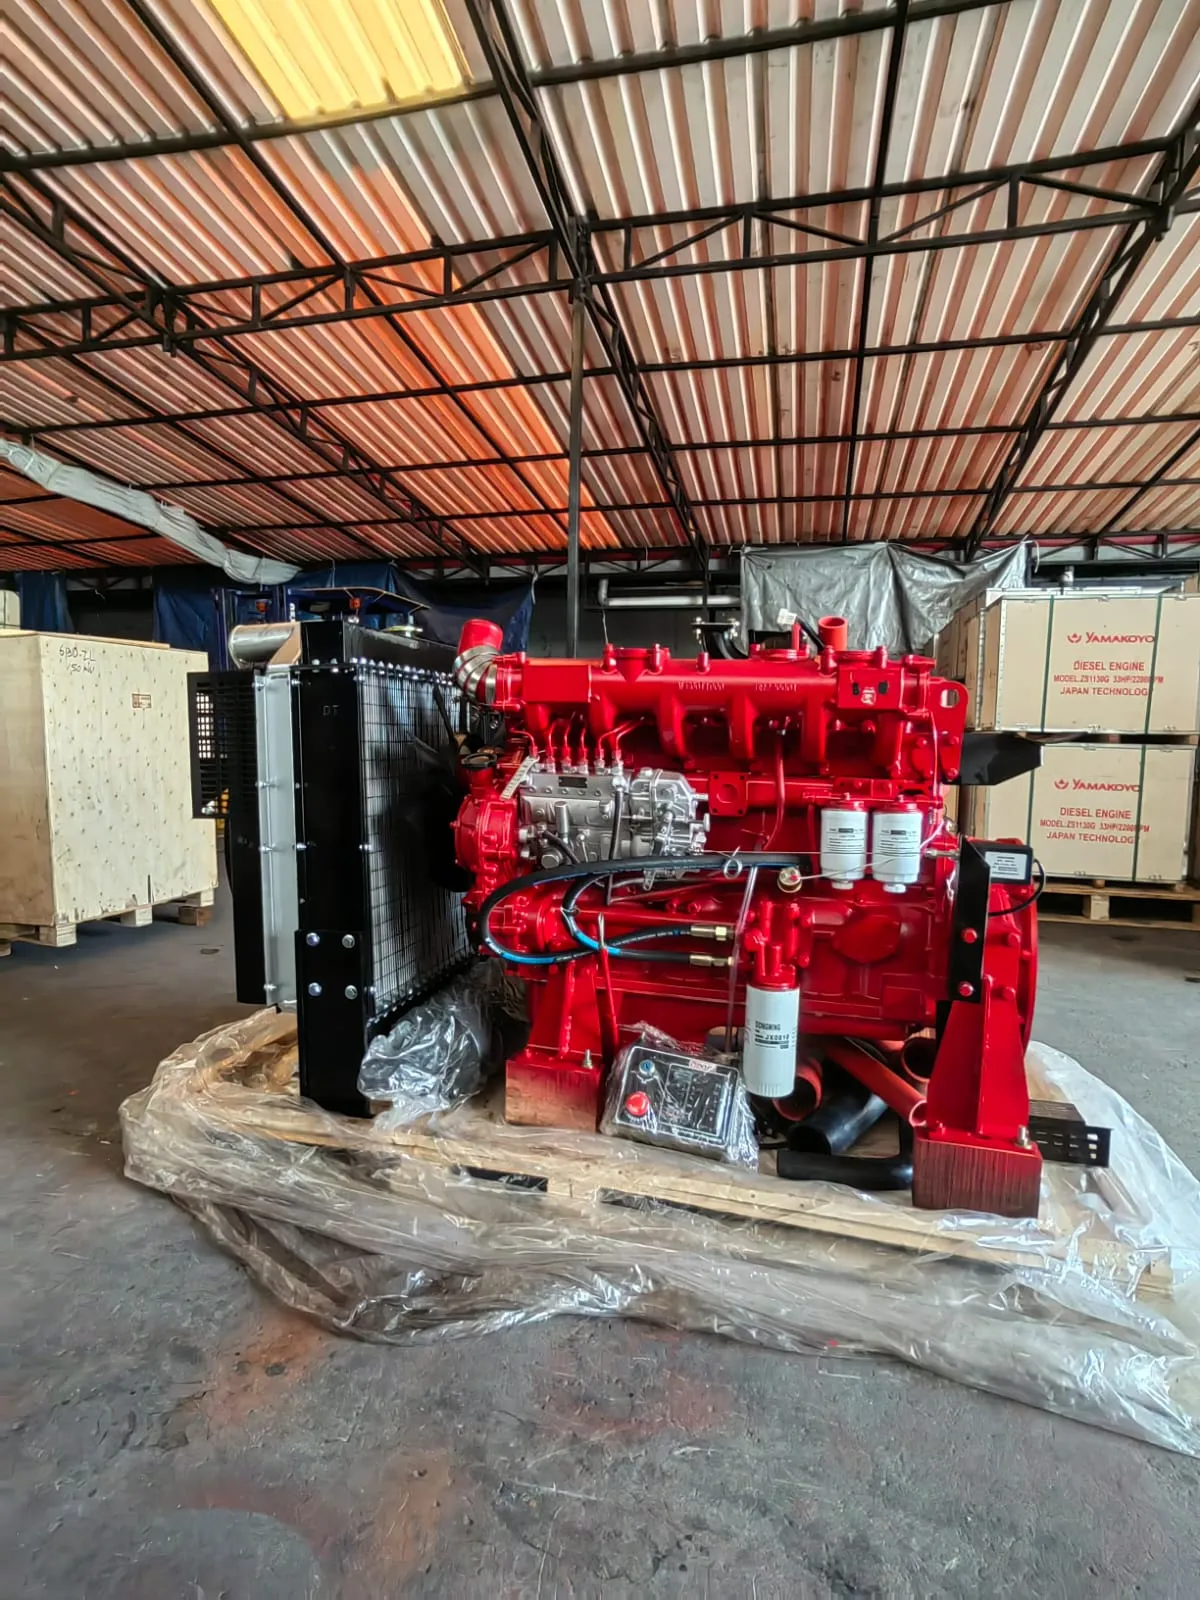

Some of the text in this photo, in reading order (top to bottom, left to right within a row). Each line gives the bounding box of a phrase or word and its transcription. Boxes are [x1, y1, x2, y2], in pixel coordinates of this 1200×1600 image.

[1086, 632, 1155, 643] YAMAKOYO
[1073, 660, 1145, 671] DIESEL ENGINE
[1060, 687, 1153, 696] JAPAN TECHNOLOG
[1072, 778, 1141, 792] YAMAKOYO
[1060, 807, 1132, 819] DIESEL ENGINE
[1046, 831, 1140, 844] JAPAN TECHNOLOG
